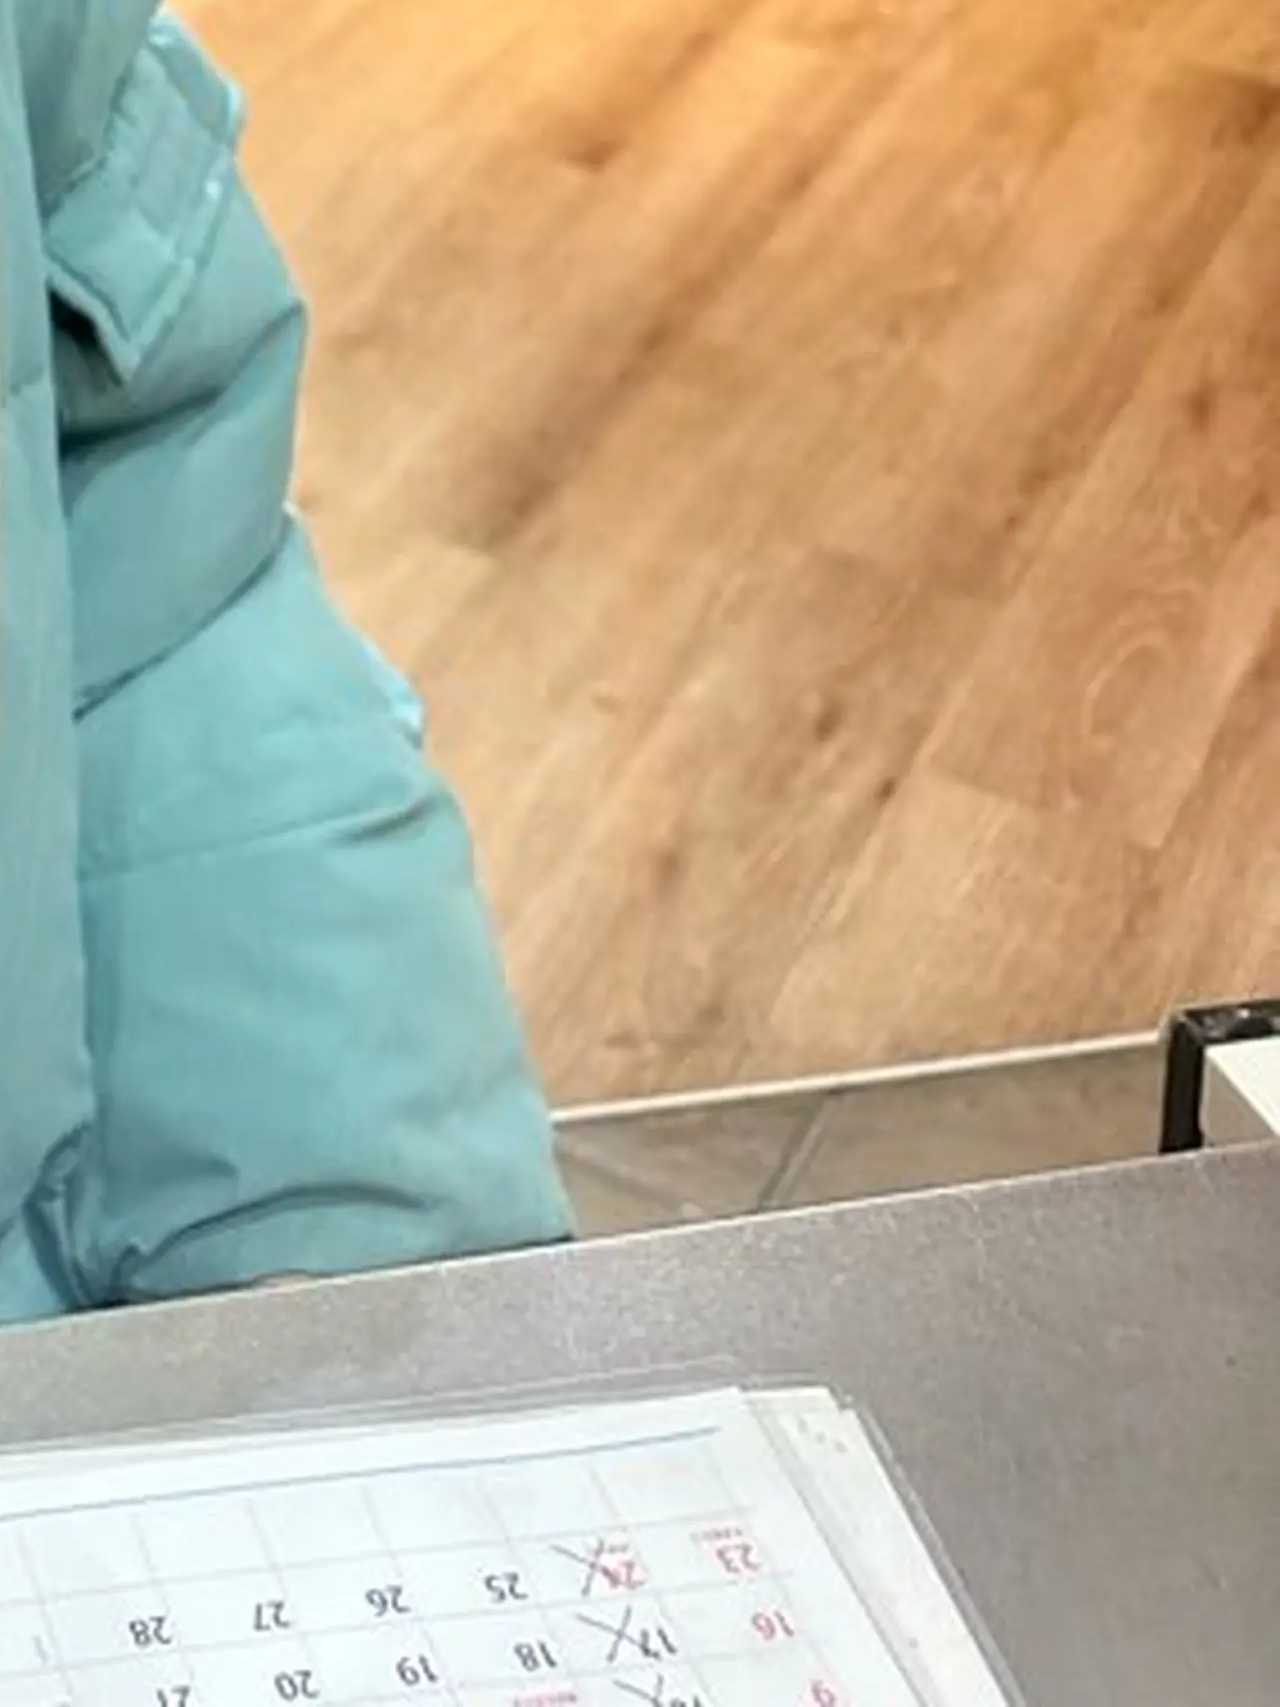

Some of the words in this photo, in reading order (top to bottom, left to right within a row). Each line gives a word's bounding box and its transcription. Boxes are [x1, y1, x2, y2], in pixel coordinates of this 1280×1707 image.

[716, 1544, 761, 1573] 23
[365, 1585, 410, 1617] 26
[484, 1572, 527, 1603] 25
[253, 1600, 291, 1631] 27
[750, 1610, 794, 1640] 16
[128, 1616, 172, 1647] 28
[395, 1654, 439, 1686] 19
[514, 1640, 557, 1671] 18
[273, 1670, 320, 1701] 20
